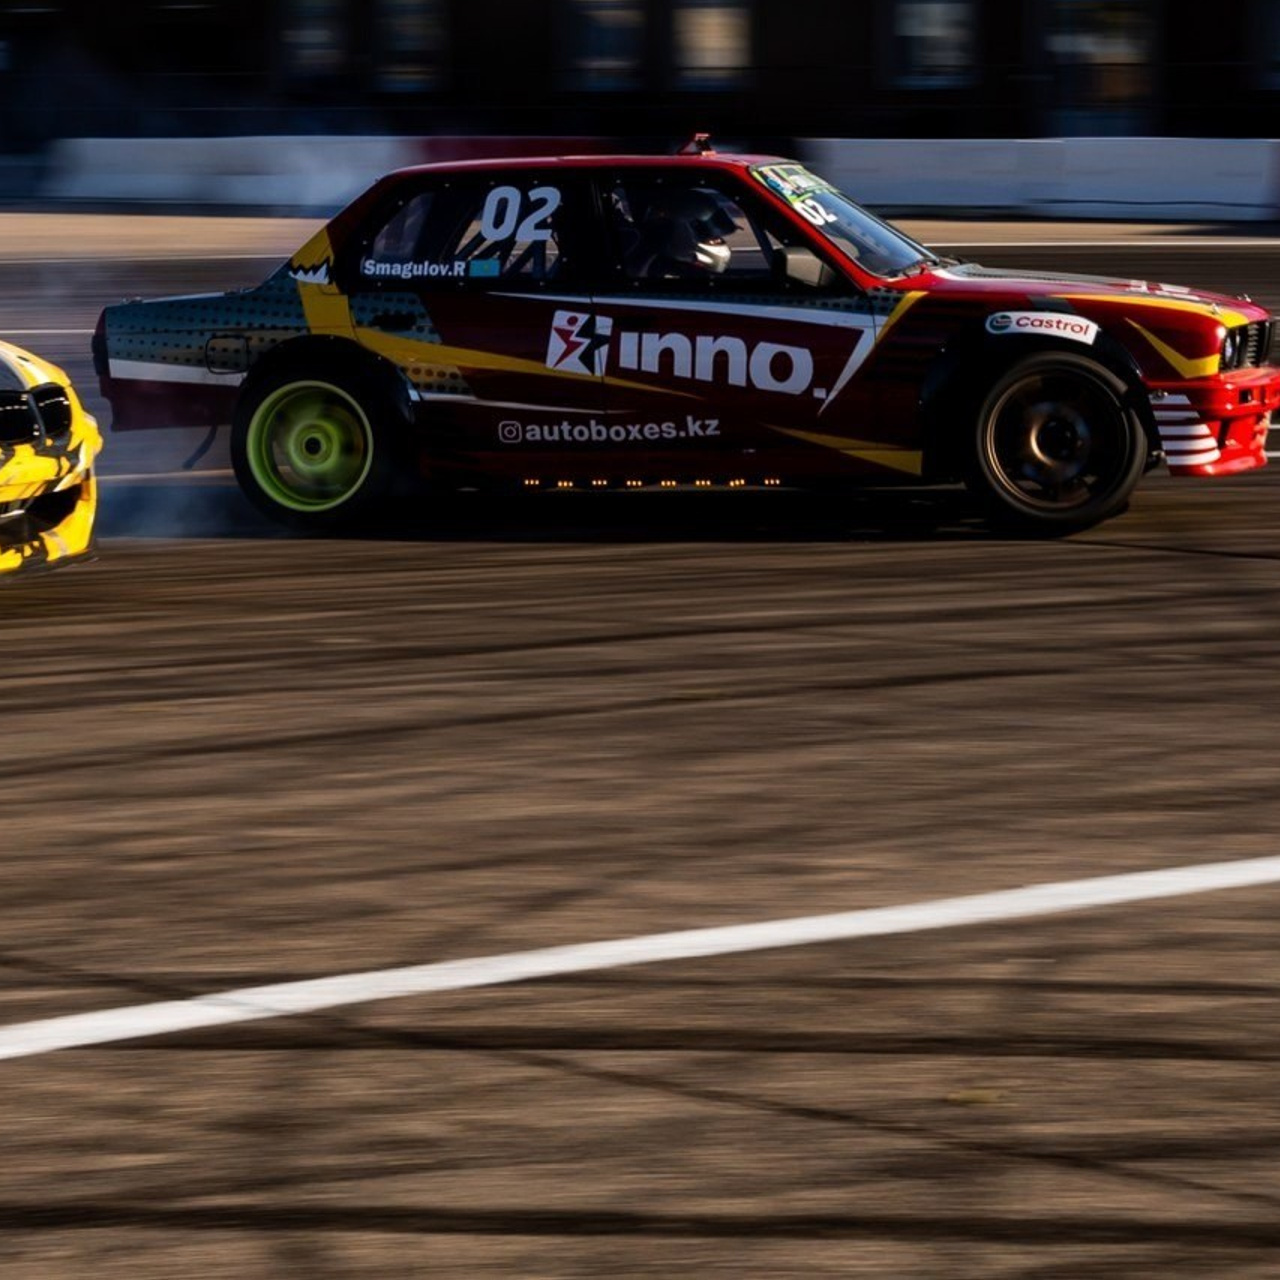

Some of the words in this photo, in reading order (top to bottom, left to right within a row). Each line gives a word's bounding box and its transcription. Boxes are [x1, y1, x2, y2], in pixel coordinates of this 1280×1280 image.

[480, 185, 562, 242] 02
[793, 199, 838, 226] 02
[363, 259, 466, 278] Smagulov.R
[1016, 316, 1090, 336] Castrol
[619, 331, 827, 399] inno.
[525, 415, 721, 443] autoboxes.kz
